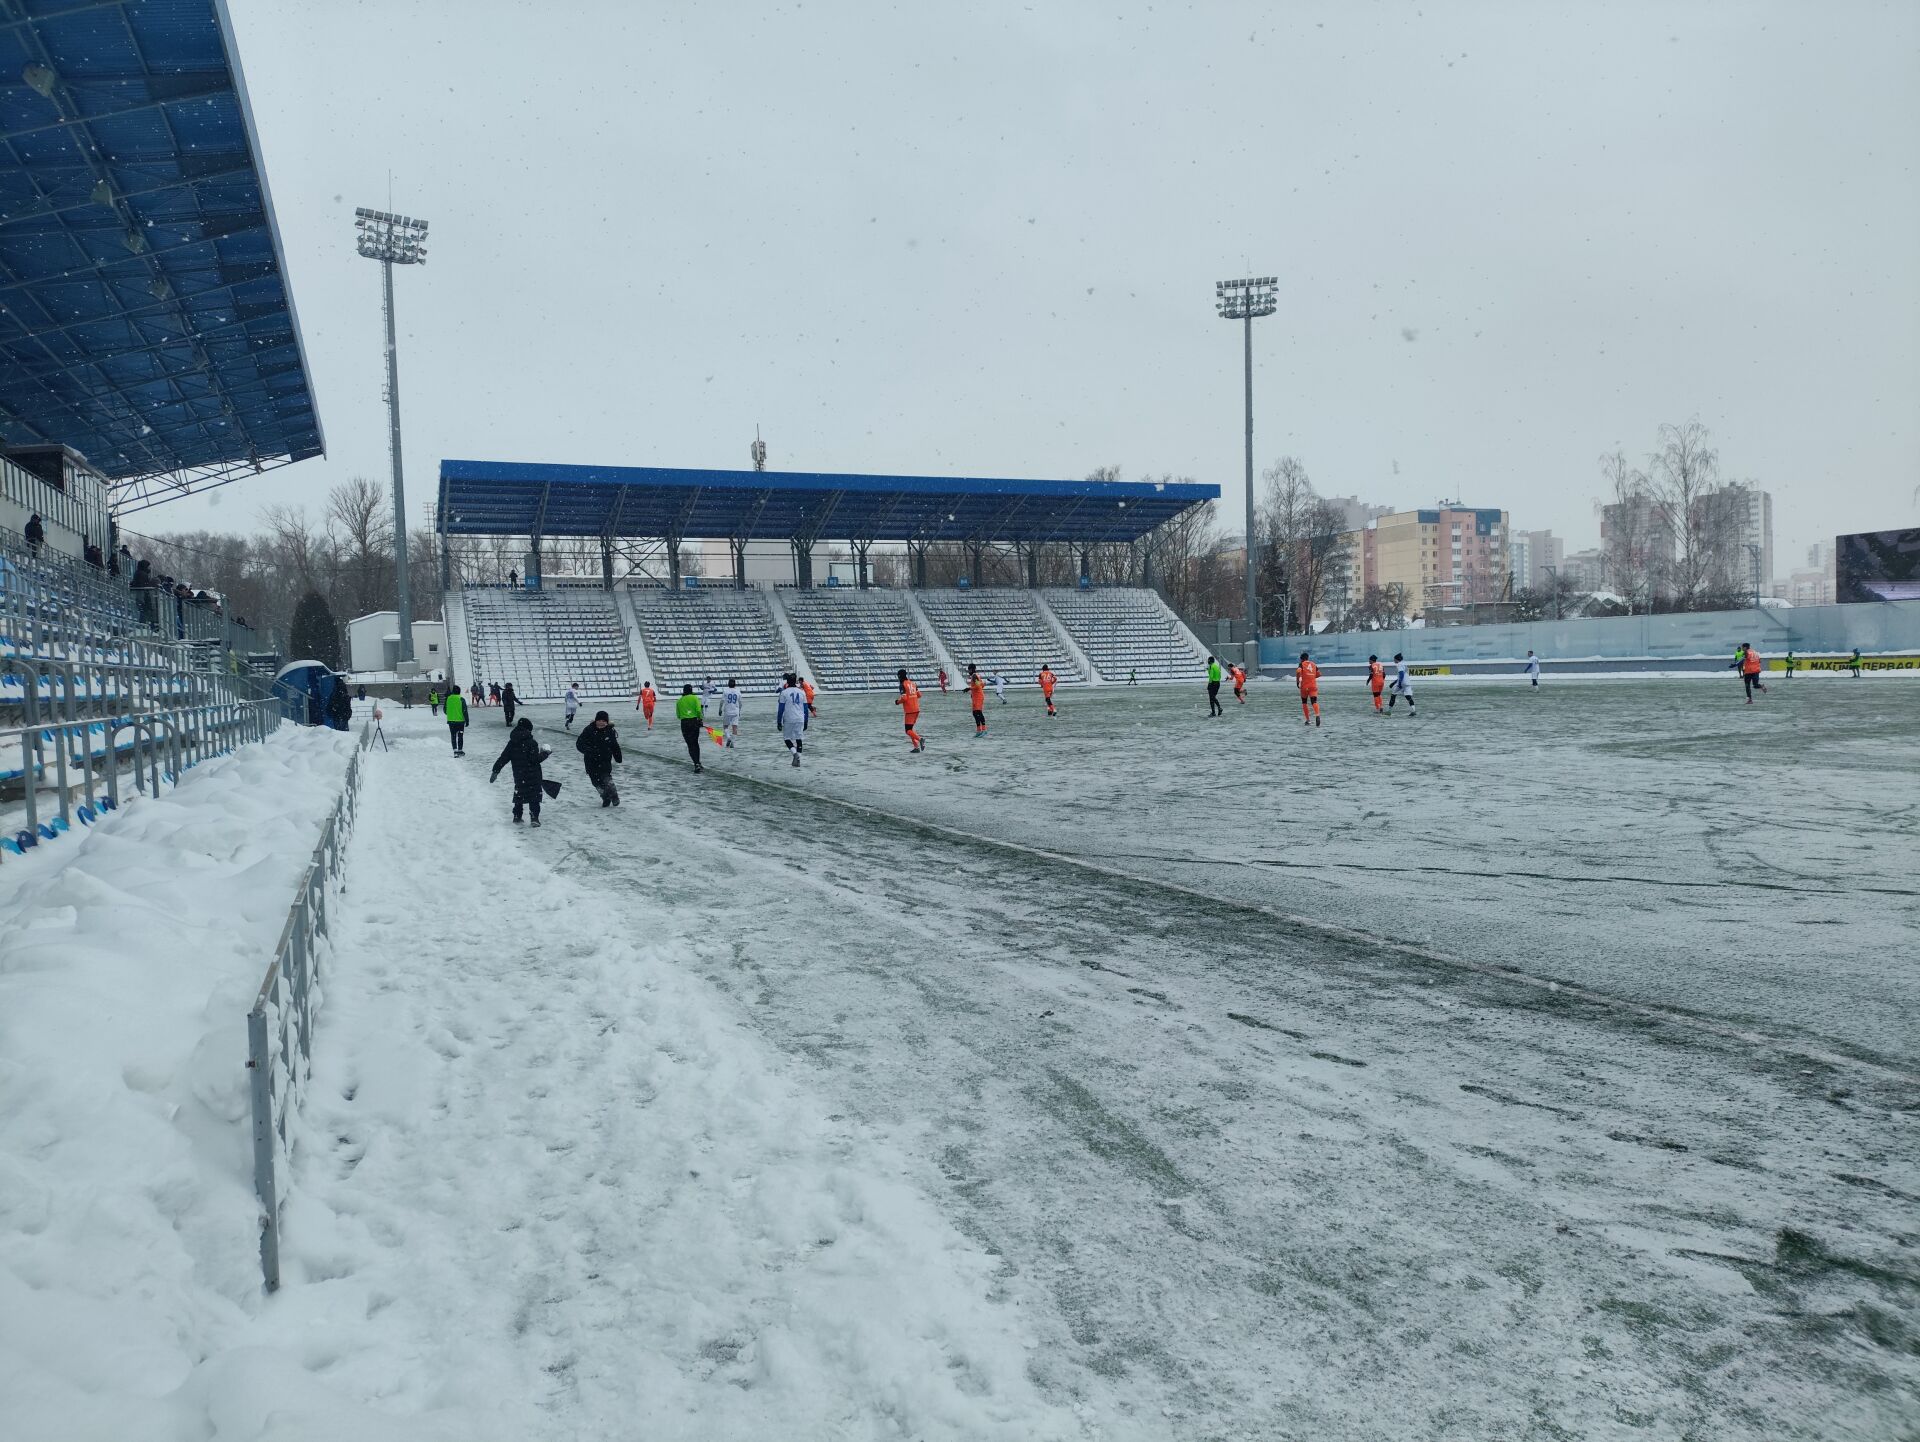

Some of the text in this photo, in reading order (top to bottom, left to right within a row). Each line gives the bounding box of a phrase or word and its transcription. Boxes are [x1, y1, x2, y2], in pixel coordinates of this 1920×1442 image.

[1307, 664, 1313, 673] 4
[1862, 662, 1913, 671] ПЕРВАЯ
[727, 693, 738, 705] 99
[789, 692, 800, 705] 14
